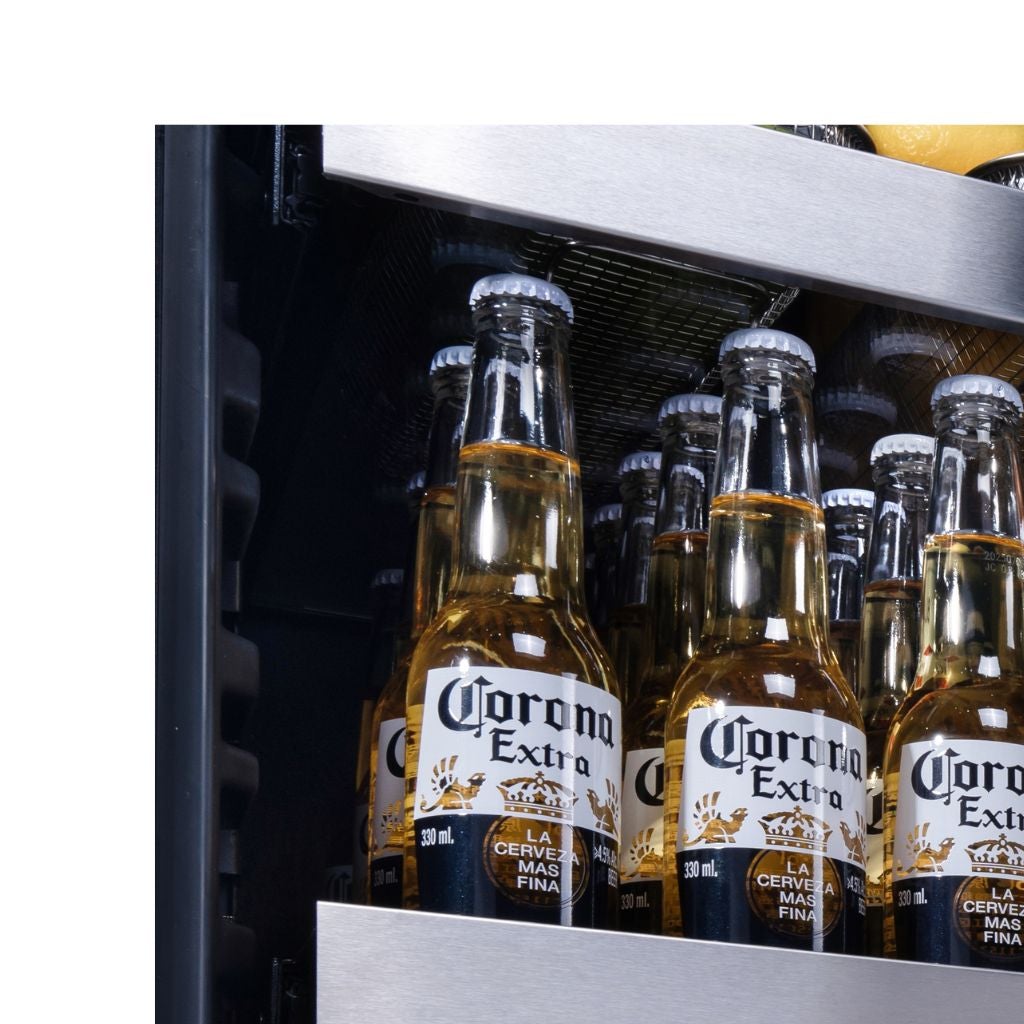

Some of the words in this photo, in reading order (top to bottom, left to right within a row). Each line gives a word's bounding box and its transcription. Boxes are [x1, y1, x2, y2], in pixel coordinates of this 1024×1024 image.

[438, 675, 615, 749] Corona
[488, 728, 591, 778] Extra
[700, 714, 863, 783] Corona
[750, 765, 843, 812] Extra
[421, 828, 437, 847] 330
[527, 828, 552, 844] LA
[494, 842, 580, 866] CERVEZA
[518, 860, 560, 877] MAS
[684, 861, 700, 879] 330
[786, 860, 809, 876] LA
[517, 876, 560, 894] FINA
[757, 873, 835, 896] CERVEZA
[779, 891, 817, 907] MAS
[898, 889, 912, 906] 330
[991, 887, 1014, 901] LA
[778, 906, 817, 922] FINA
[984, 916, 1022, 931] MAS
[983, 930, 1023, 946] FINA
